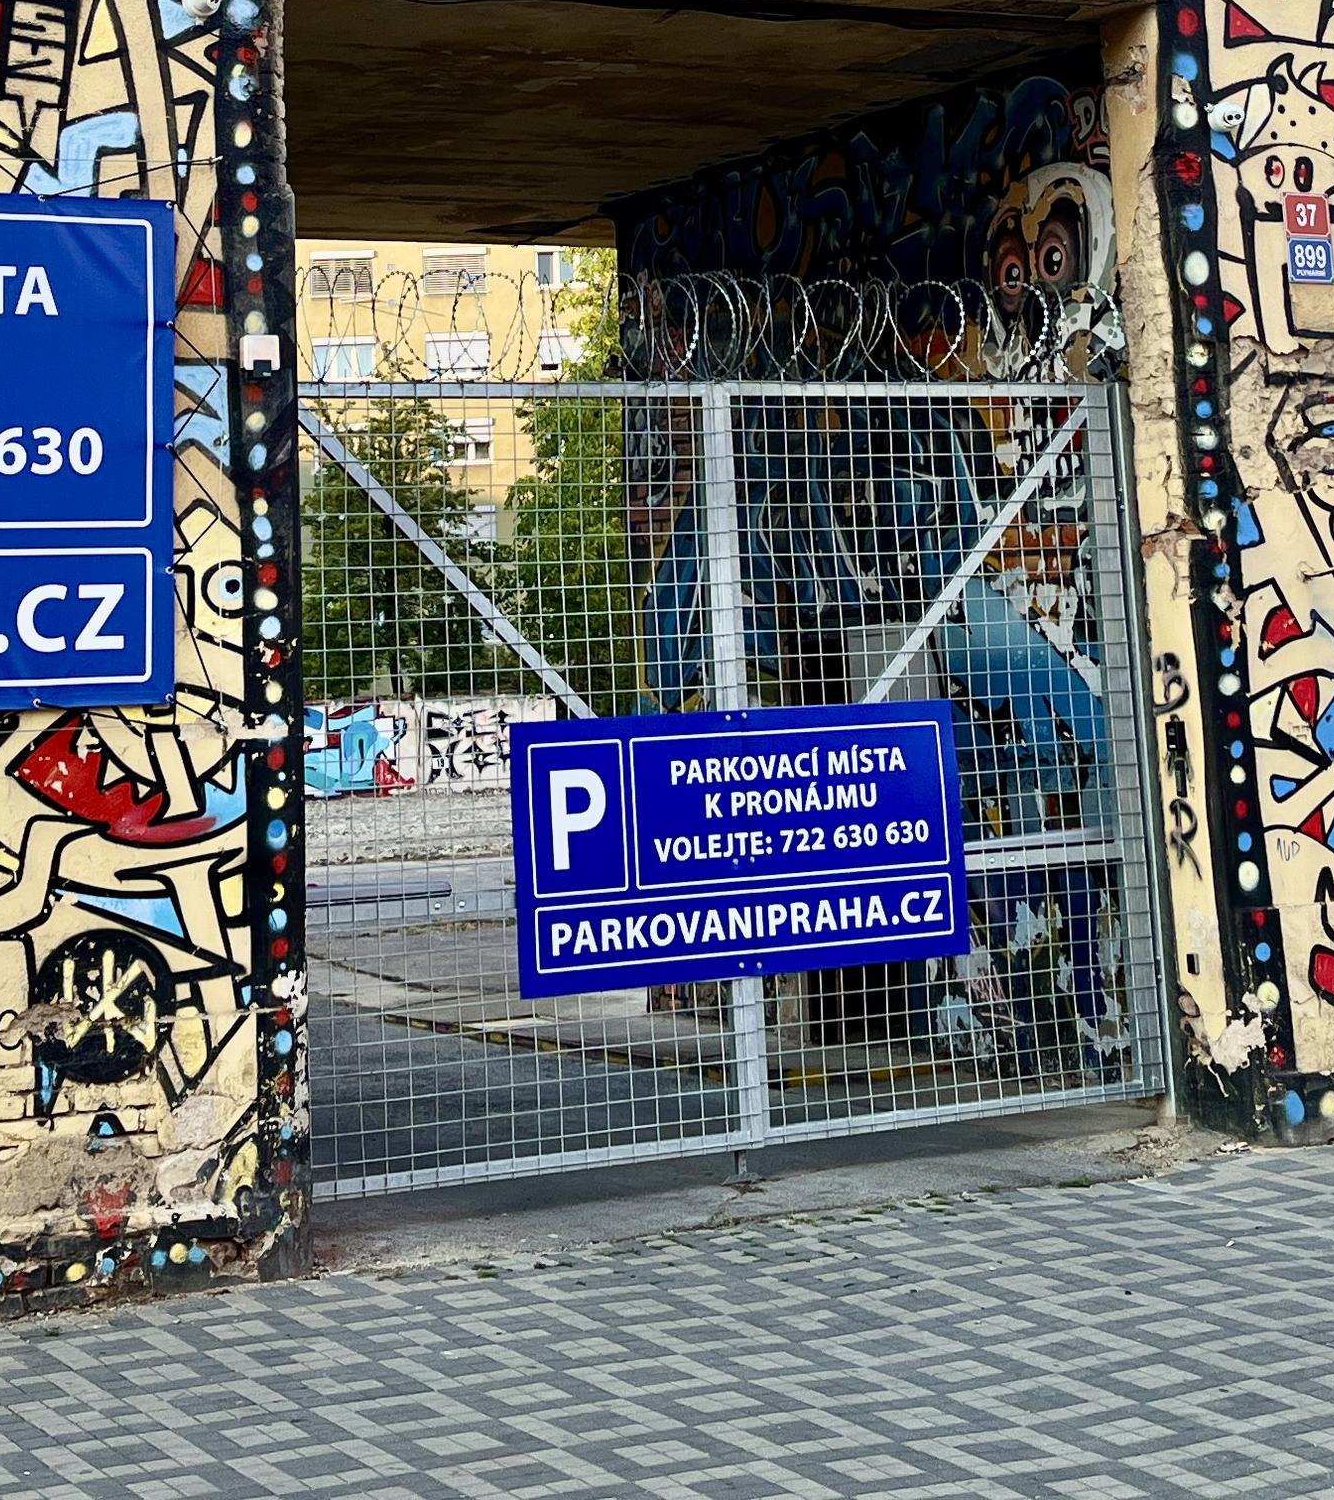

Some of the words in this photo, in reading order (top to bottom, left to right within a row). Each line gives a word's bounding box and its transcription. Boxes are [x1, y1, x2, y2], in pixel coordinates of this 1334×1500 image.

[1295, 203, 1317, 227] 37
[1294, 244, 1327, 269] 899
[670, 746, 819, 786] PARKOVACÍ
[827, 744, 907, 776] MÍSTA
[549, 768, 607, 871] P
[704, 792, 724, 819] K
[730, 782, 878, 818] PRONÁJMU
[653, 830, 773, 863] VOLEJTE:
[779, 827, 826, 853] 722
[833, 823, 878, 849] 630
[885, 819, 929, 845] 630
[551, 889, 944, 957] PARKOVANIPRAHA.CZ
